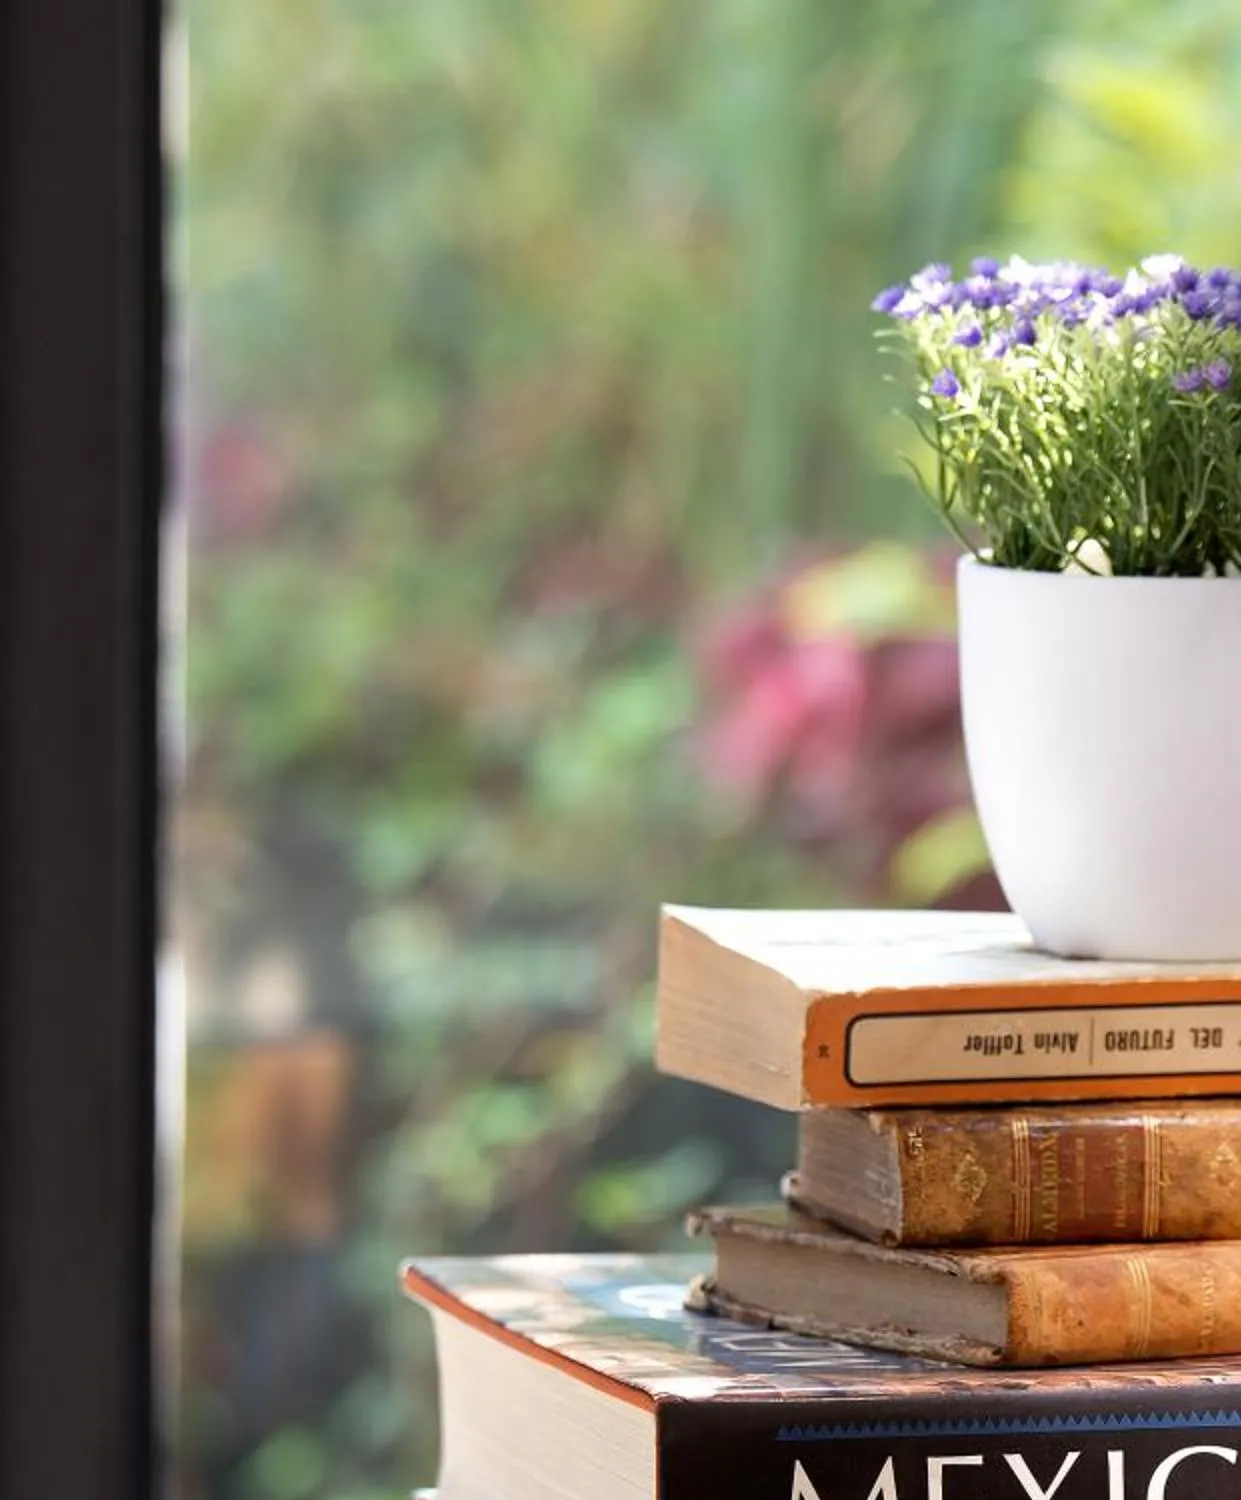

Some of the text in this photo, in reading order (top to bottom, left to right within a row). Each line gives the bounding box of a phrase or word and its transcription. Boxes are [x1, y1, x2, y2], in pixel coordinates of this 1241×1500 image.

[1034, 1032, 1080, 1055] Alvin
[1104, 1029, 1175, 1053] FUTURO
[1189, 1026, 1223, 1048] DEL
